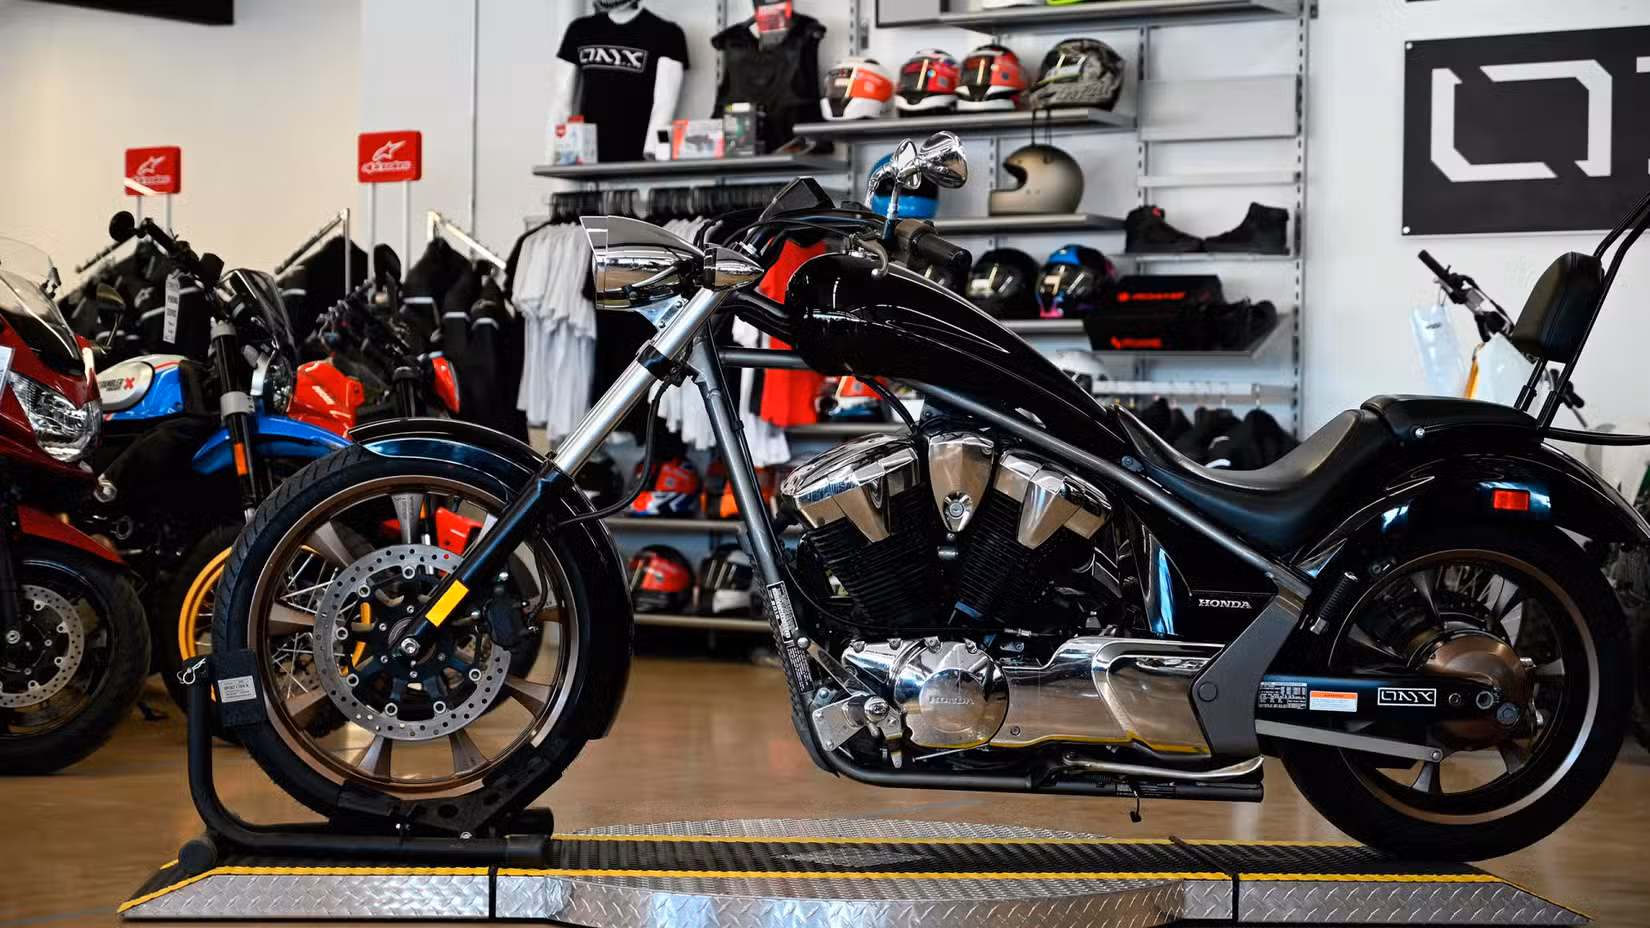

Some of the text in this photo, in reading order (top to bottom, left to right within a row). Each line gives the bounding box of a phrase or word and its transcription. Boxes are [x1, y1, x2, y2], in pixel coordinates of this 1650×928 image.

[580, 48, 643, 68] ONYX
[1431, 59, 1650, 182] O
[1199, 599, 1252, 609] HONDA
[928, 697, 975, 705] HONDA
[1381, 691, 1433, 703] ONYX
